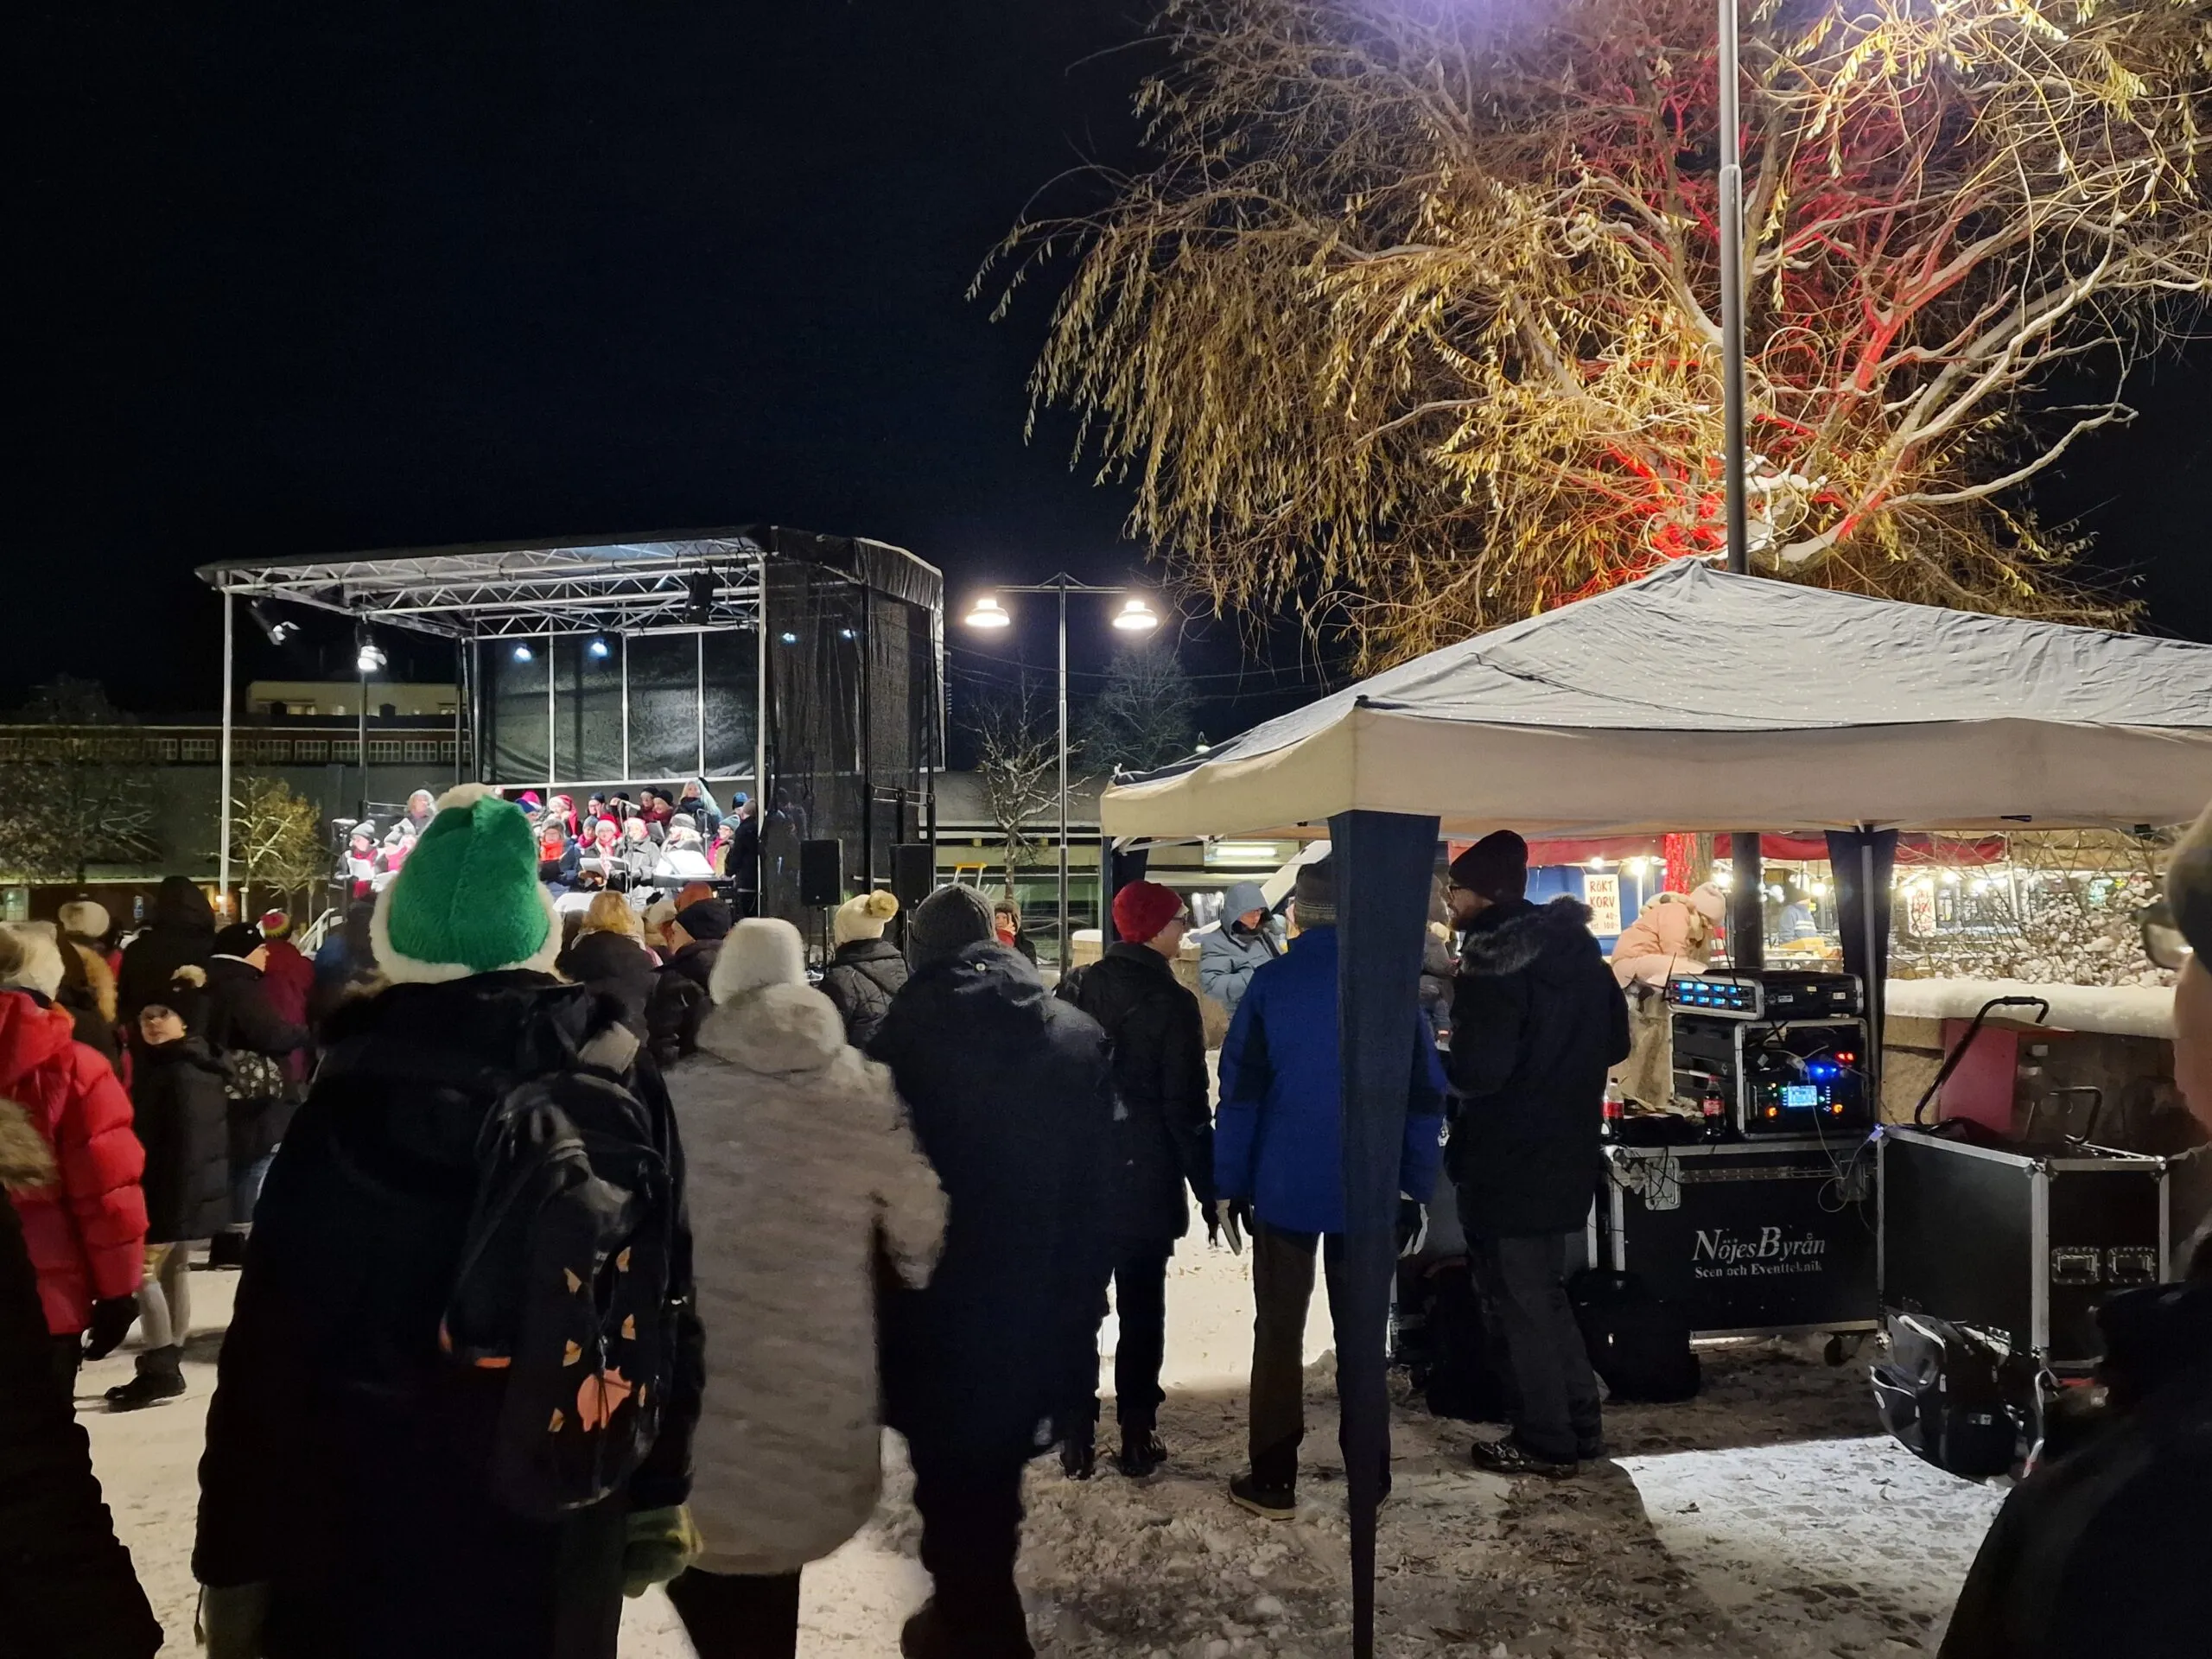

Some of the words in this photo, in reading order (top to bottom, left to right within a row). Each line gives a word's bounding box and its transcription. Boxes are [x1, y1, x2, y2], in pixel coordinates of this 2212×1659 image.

[1590, 880, 1614, 893] RÖKT
[1589, 896, 1616, 908] KORV
[1694, 1266, 1723, 1279] Scen
[1726, 1263, 1748, 1277] och
[1751, 1261, 1822, 1275] Eventteknik
